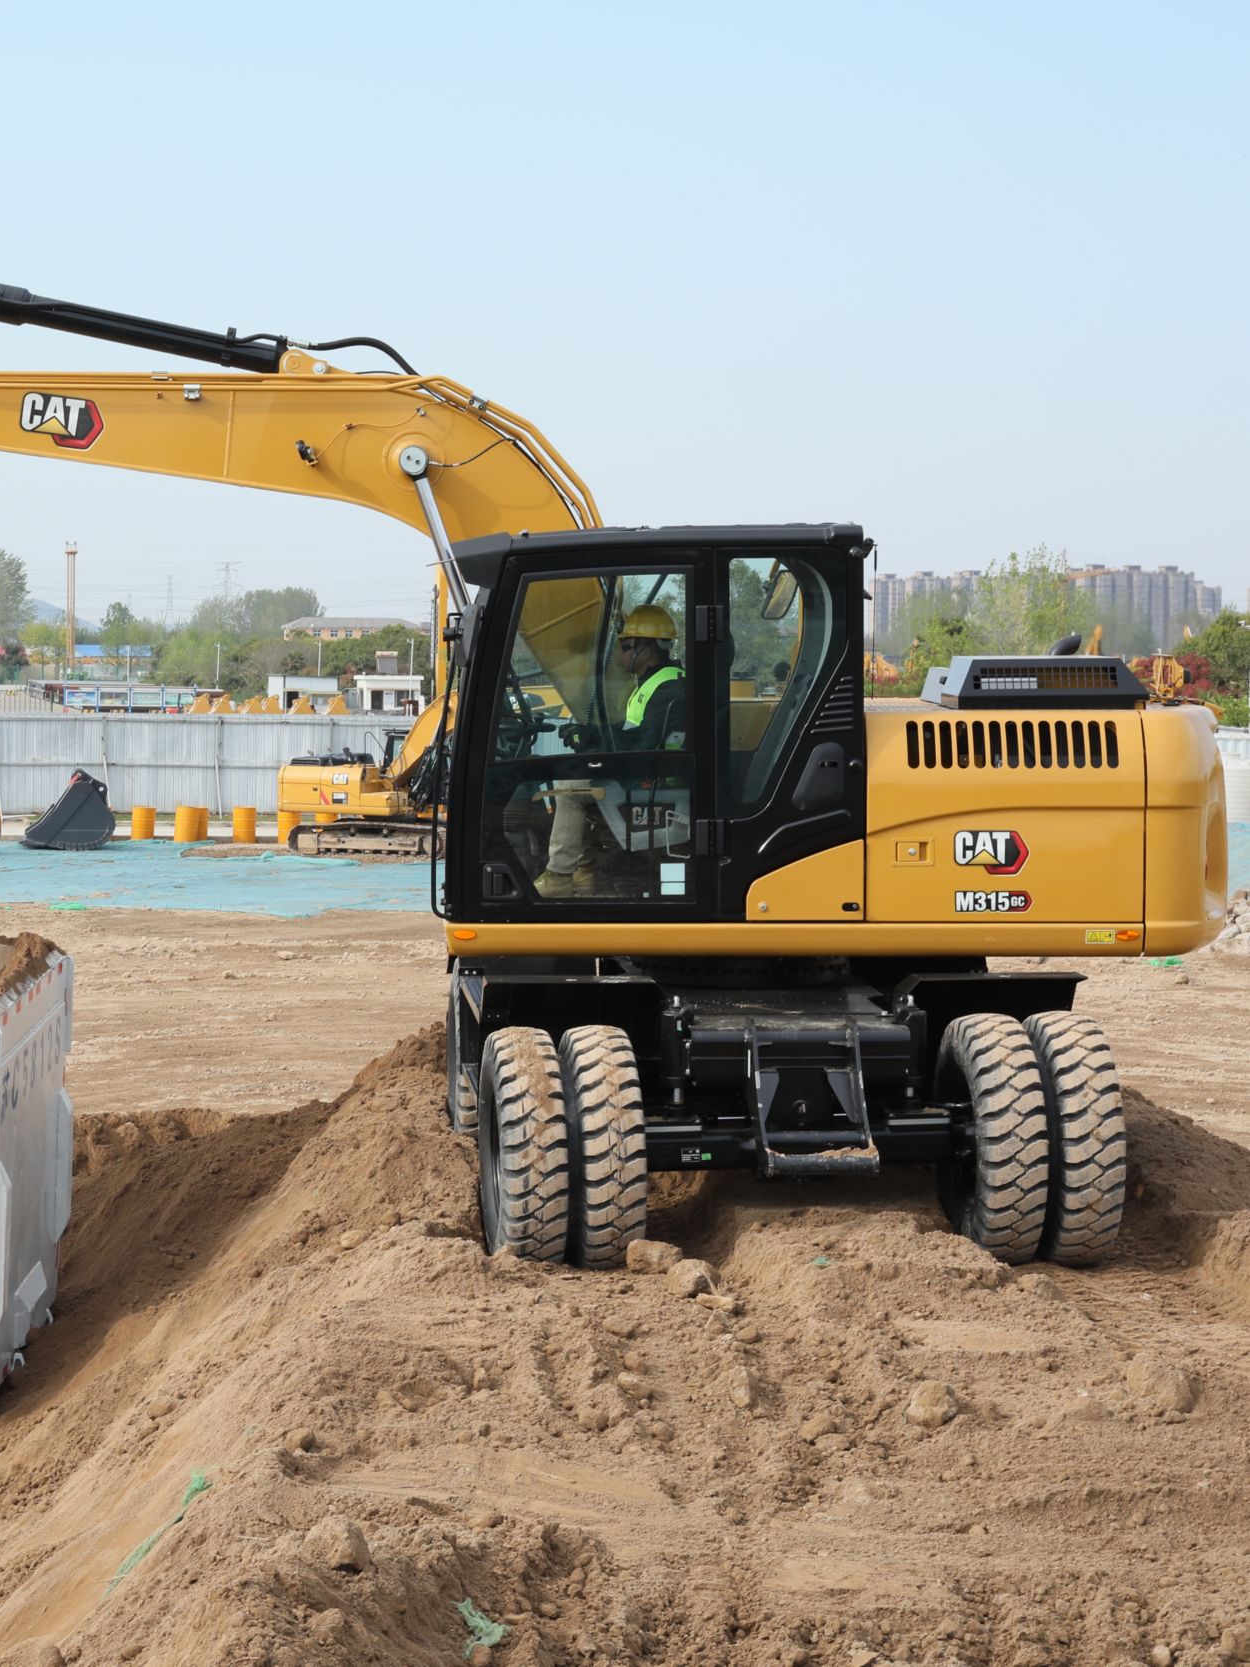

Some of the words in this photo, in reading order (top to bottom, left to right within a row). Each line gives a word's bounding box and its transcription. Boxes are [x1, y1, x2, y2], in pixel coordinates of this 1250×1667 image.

[21, 392, 86, 437] CAT
[332, 773, 349, 785] CAT
[955, 831, 1010, 865] CAT
